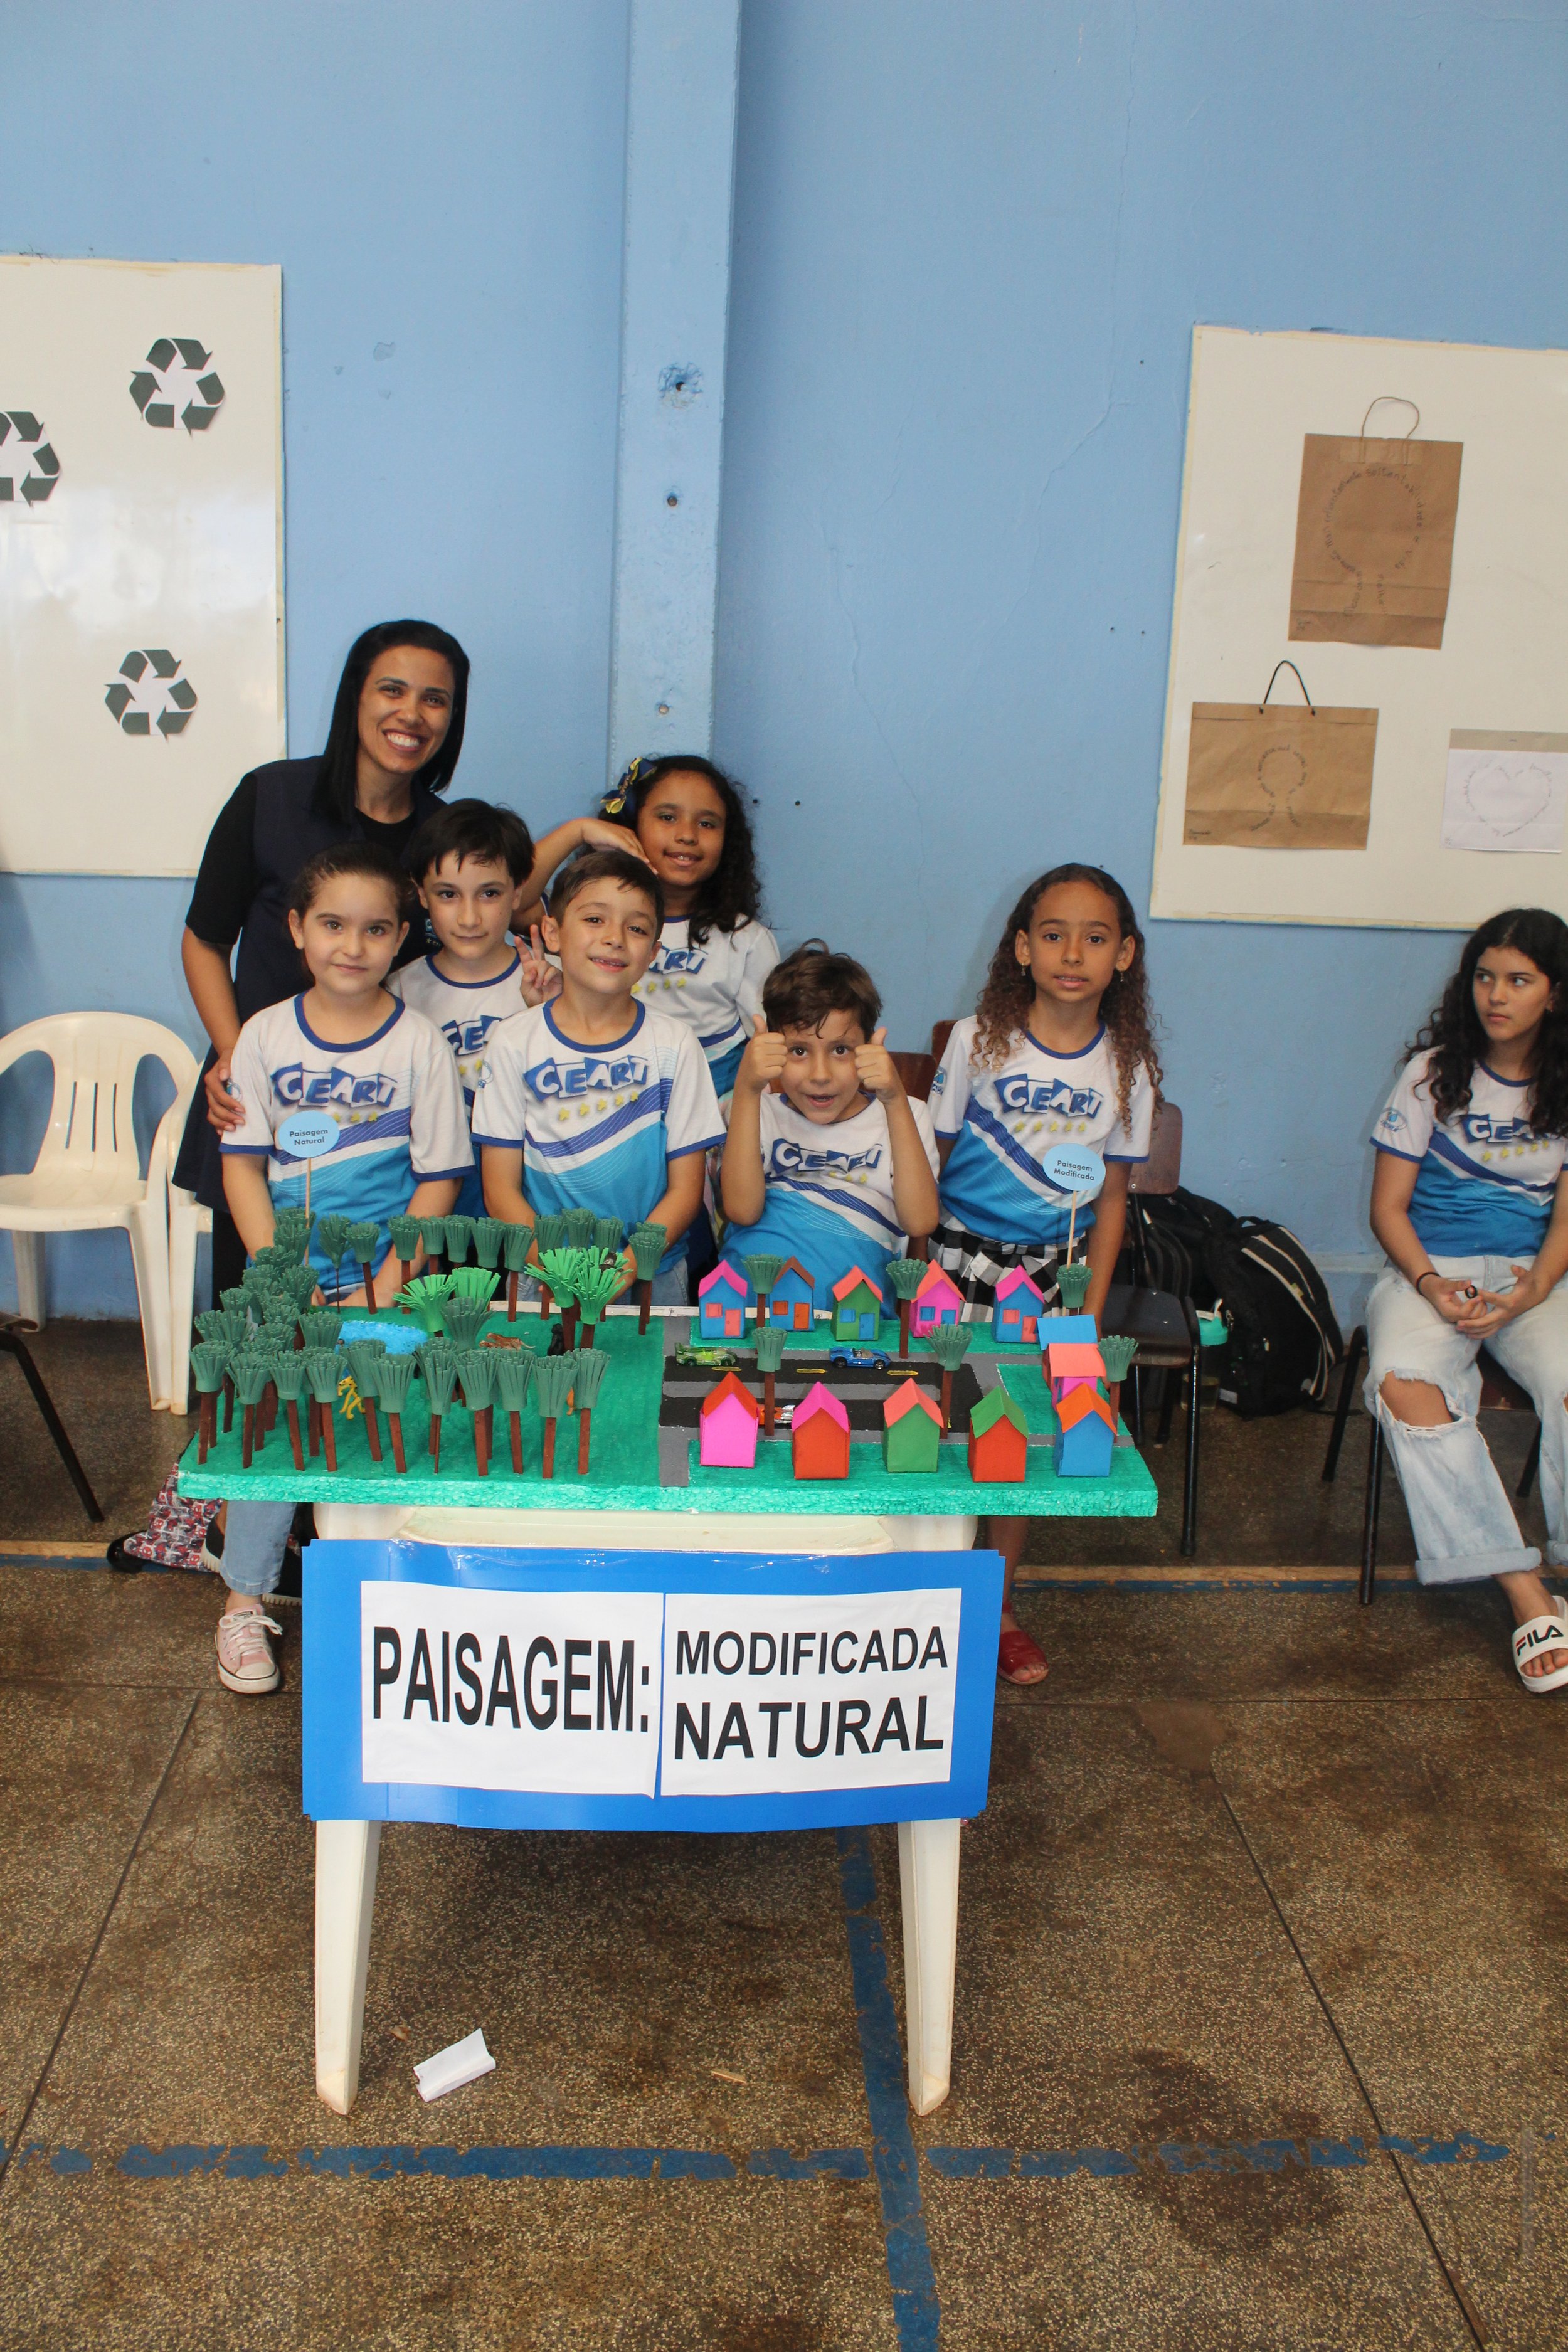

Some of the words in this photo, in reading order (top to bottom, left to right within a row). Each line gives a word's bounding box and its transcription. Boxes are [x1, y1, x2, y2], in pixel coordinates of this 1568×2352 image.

[648, 945, 708, 974] ART
[272, 1062, 398, 1107] CEART
[523, 1056, 649, 1101] CEART
[995, 1073, 1104, 1118] CEART
[294, 1136, 325, 1145] Natural
[1460, 1113, 1550, 1143] CEA
[1054, 1168, 1094, 1180] Modificada
[1057, 1160, 1093, 1172] Paisagem
[675, 1626, 948, 1675] MODIFICADA
[1515, 1625, 1564, 1656] FILA
[373, 1626, 650, 1733] PAISAGEM:
[674, 1695, 944, 1760] NATURAL
